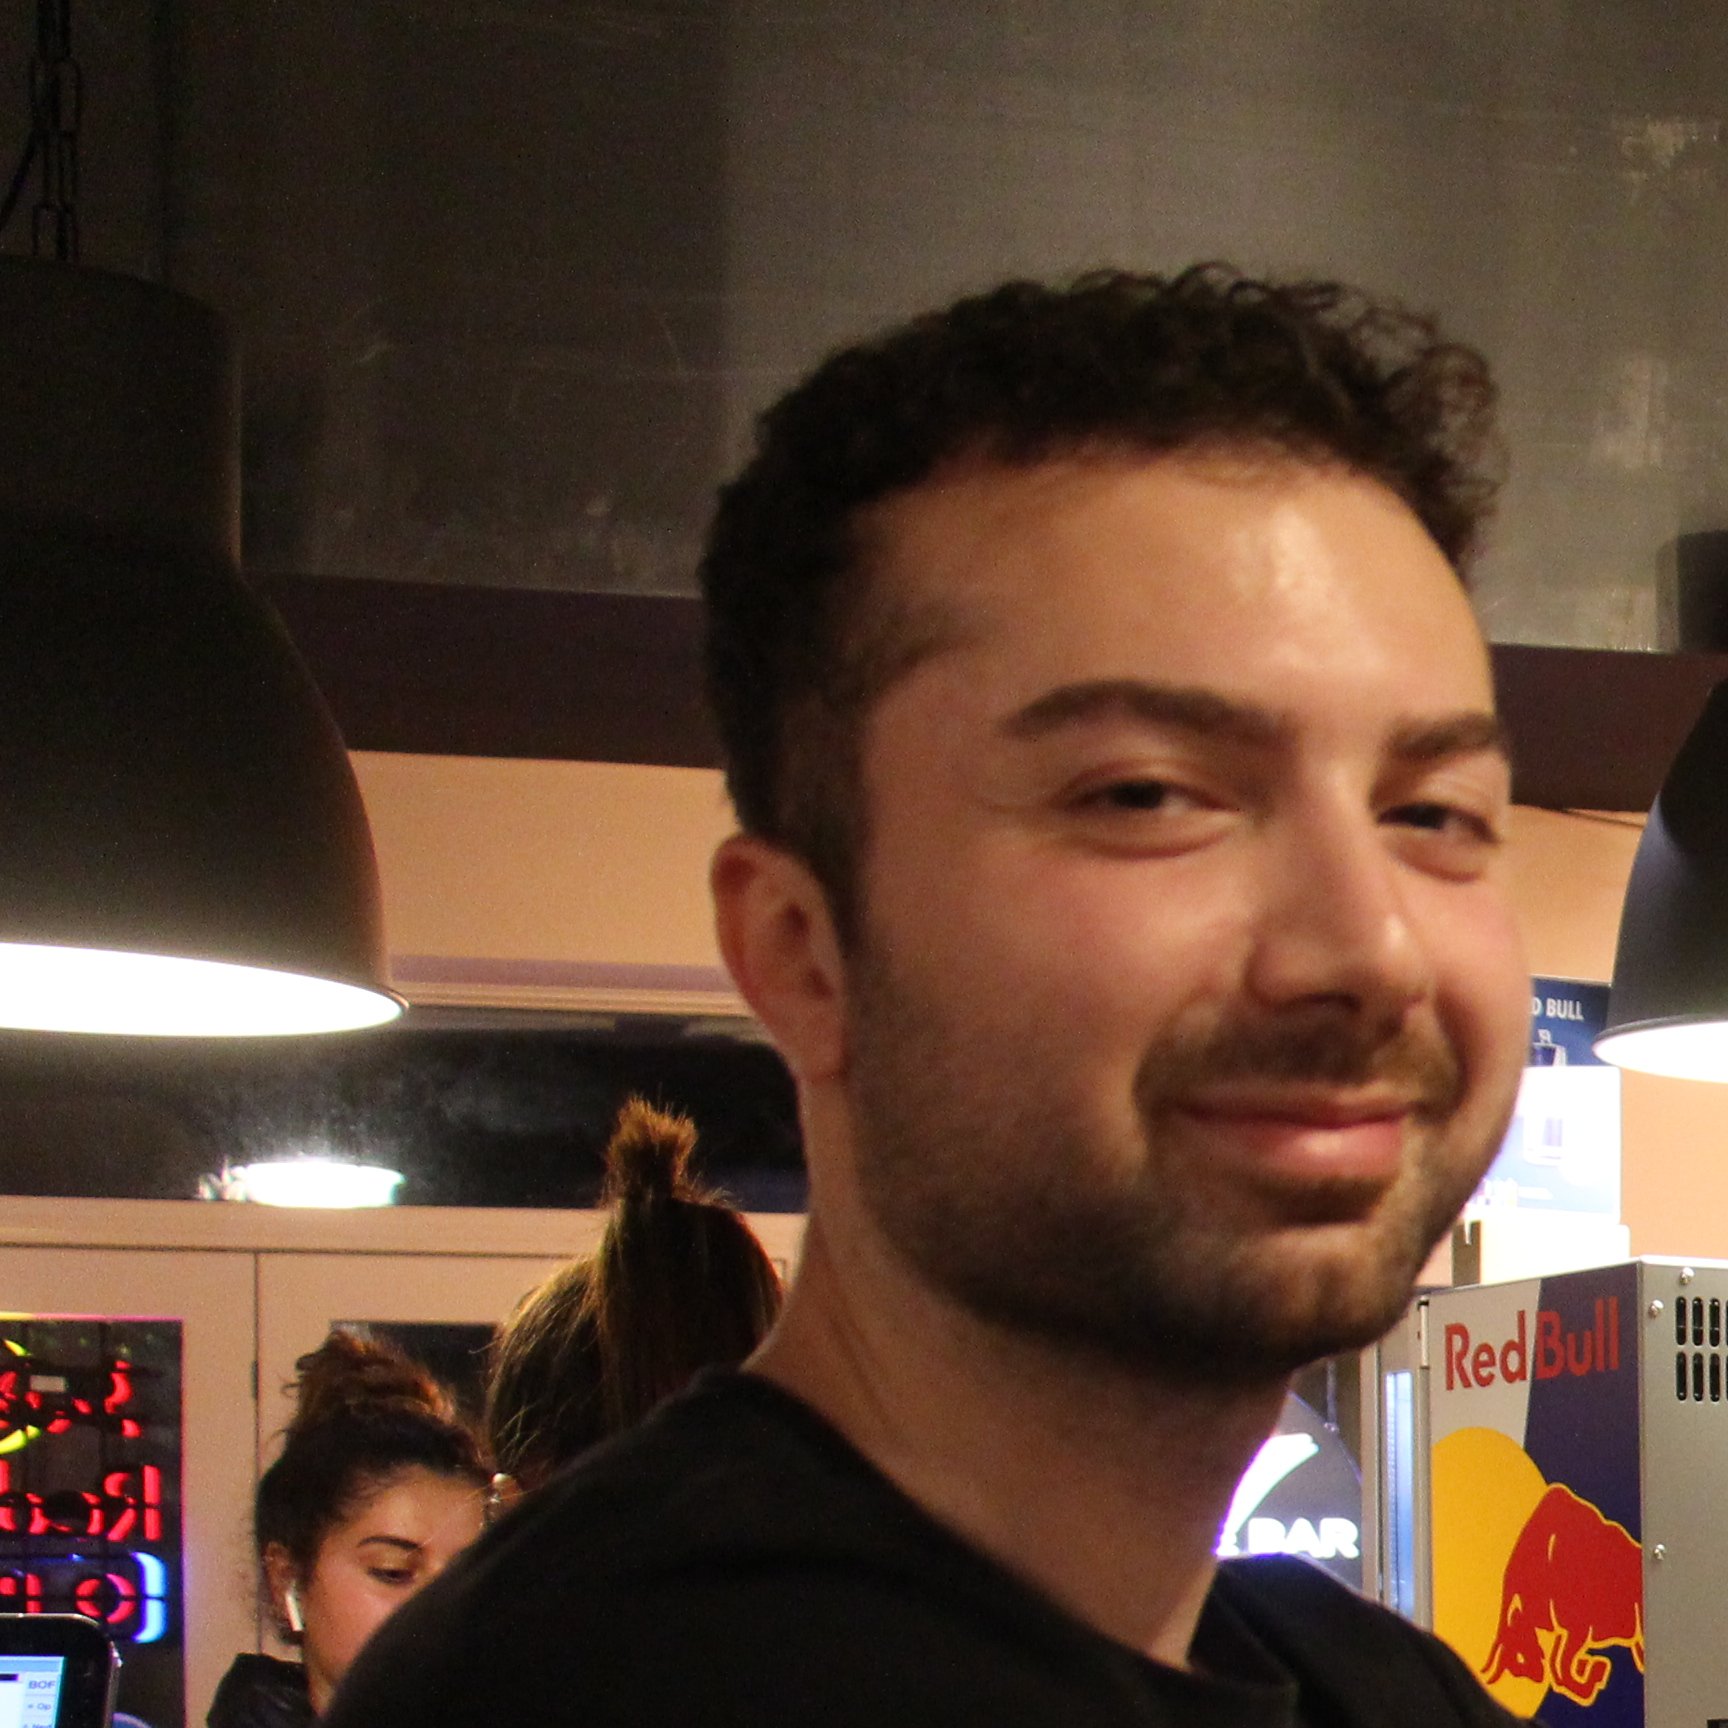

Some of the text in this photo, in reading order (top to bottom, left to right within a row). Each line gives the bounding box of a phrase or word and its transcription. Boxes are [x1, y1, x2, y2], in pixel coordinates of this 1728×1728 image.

[1546, 998, 1584, 1020] BULL
[1444, 1296, 1620, 1391] Red Bull
[1247, 1517, 1360, 1559] BAR
